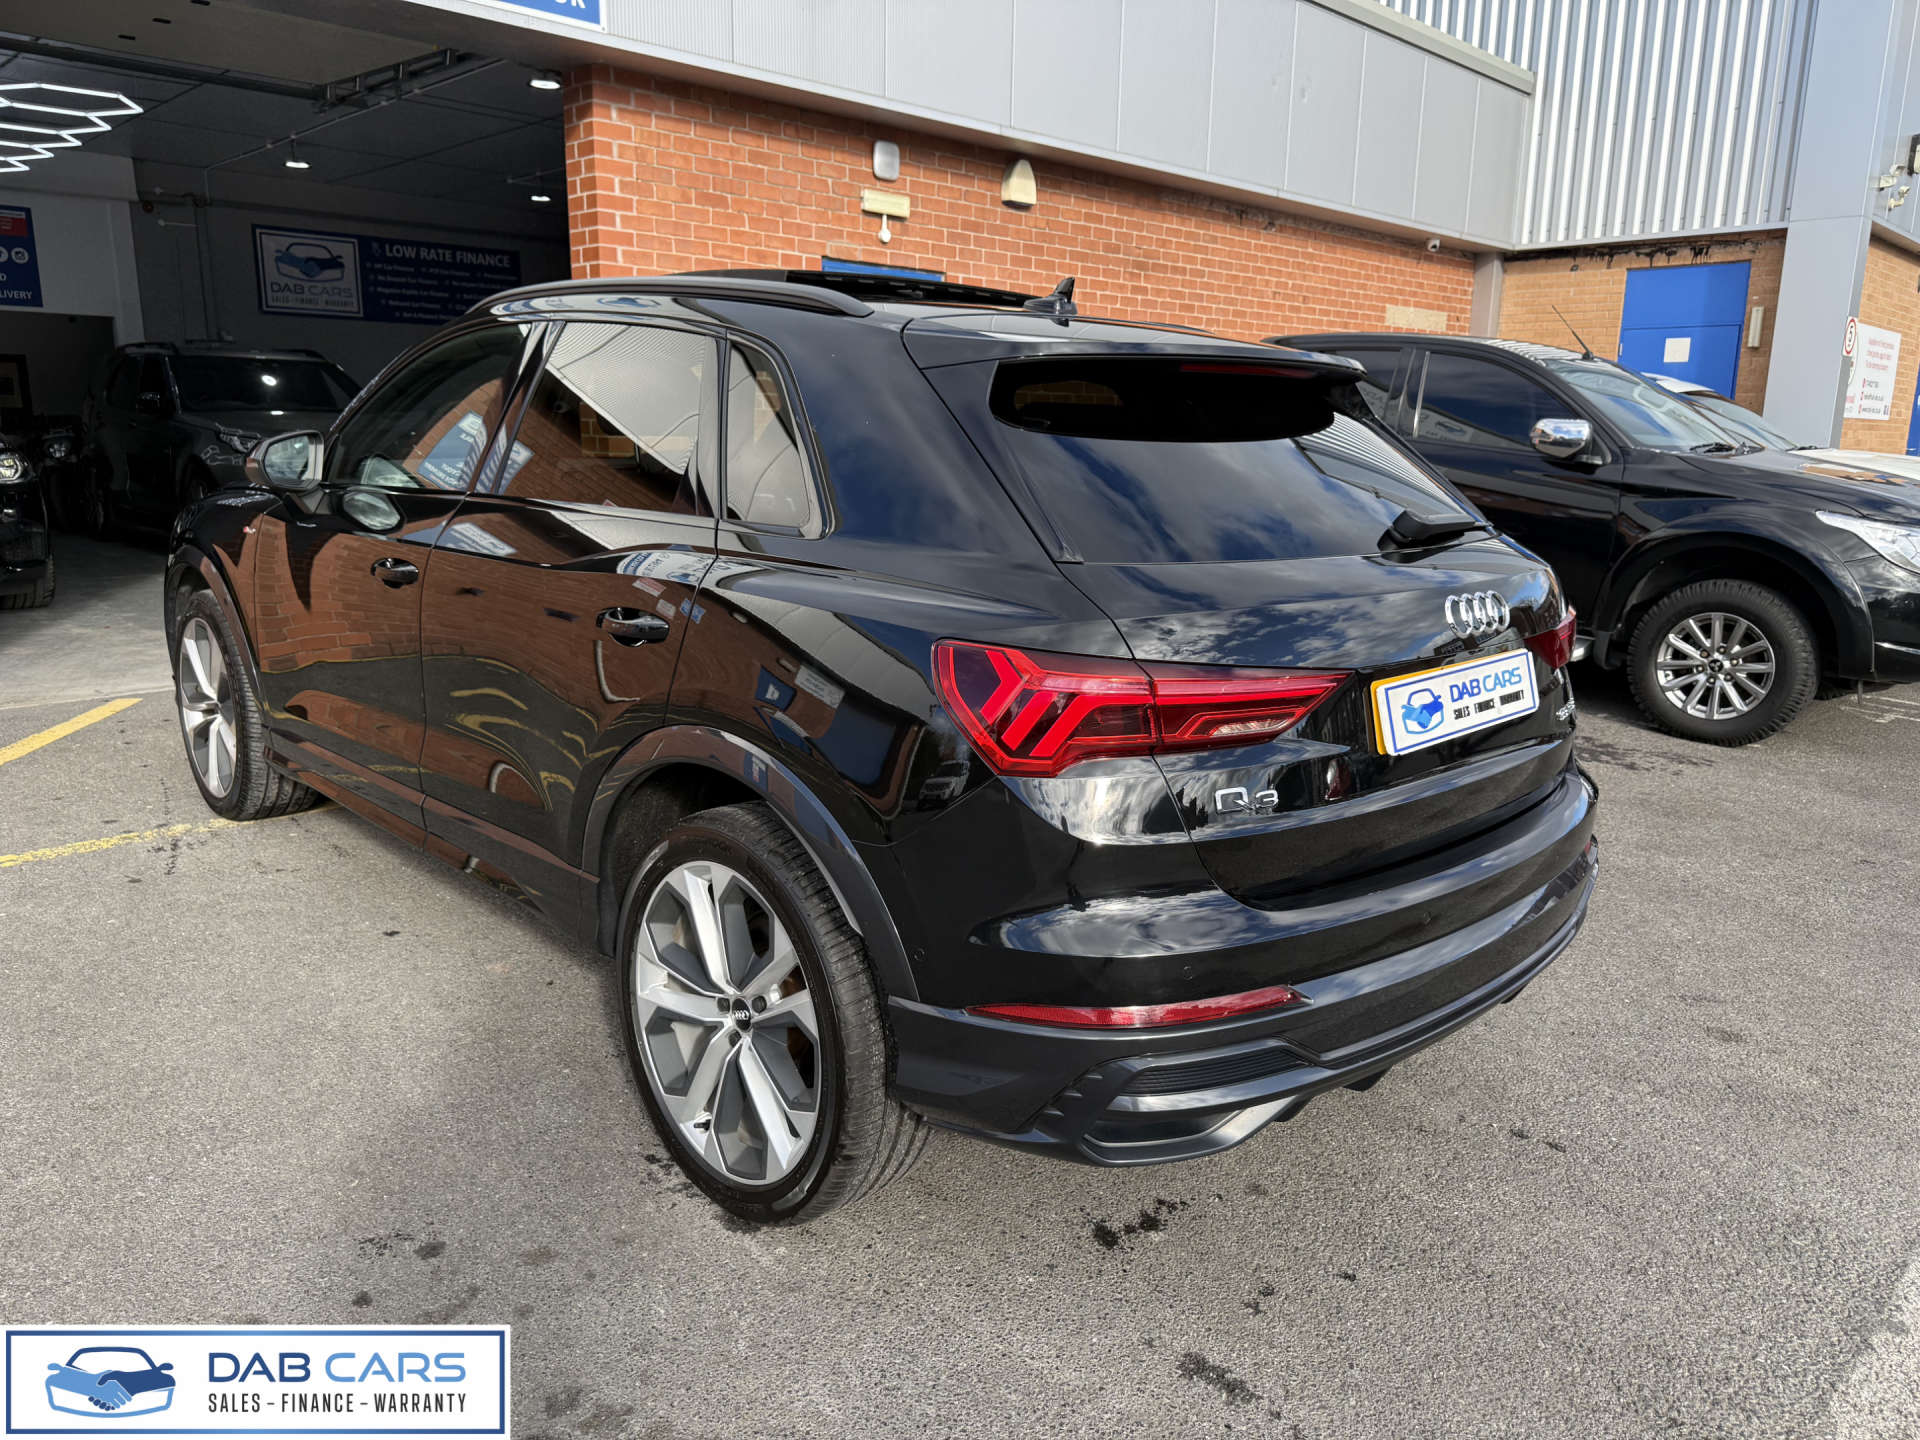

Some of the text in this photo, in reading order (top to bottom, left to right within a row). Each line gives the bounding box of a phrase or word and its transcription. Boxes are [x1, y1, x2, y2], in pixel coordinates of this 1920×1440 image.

[384, 242, 512, 269] LOW RATE FINANCE
[270, 281, 353, 298] DAB CARS
[1450, 668, 1522, 702] DAB CARS
[1215, 786, 1279, 813] Q3
